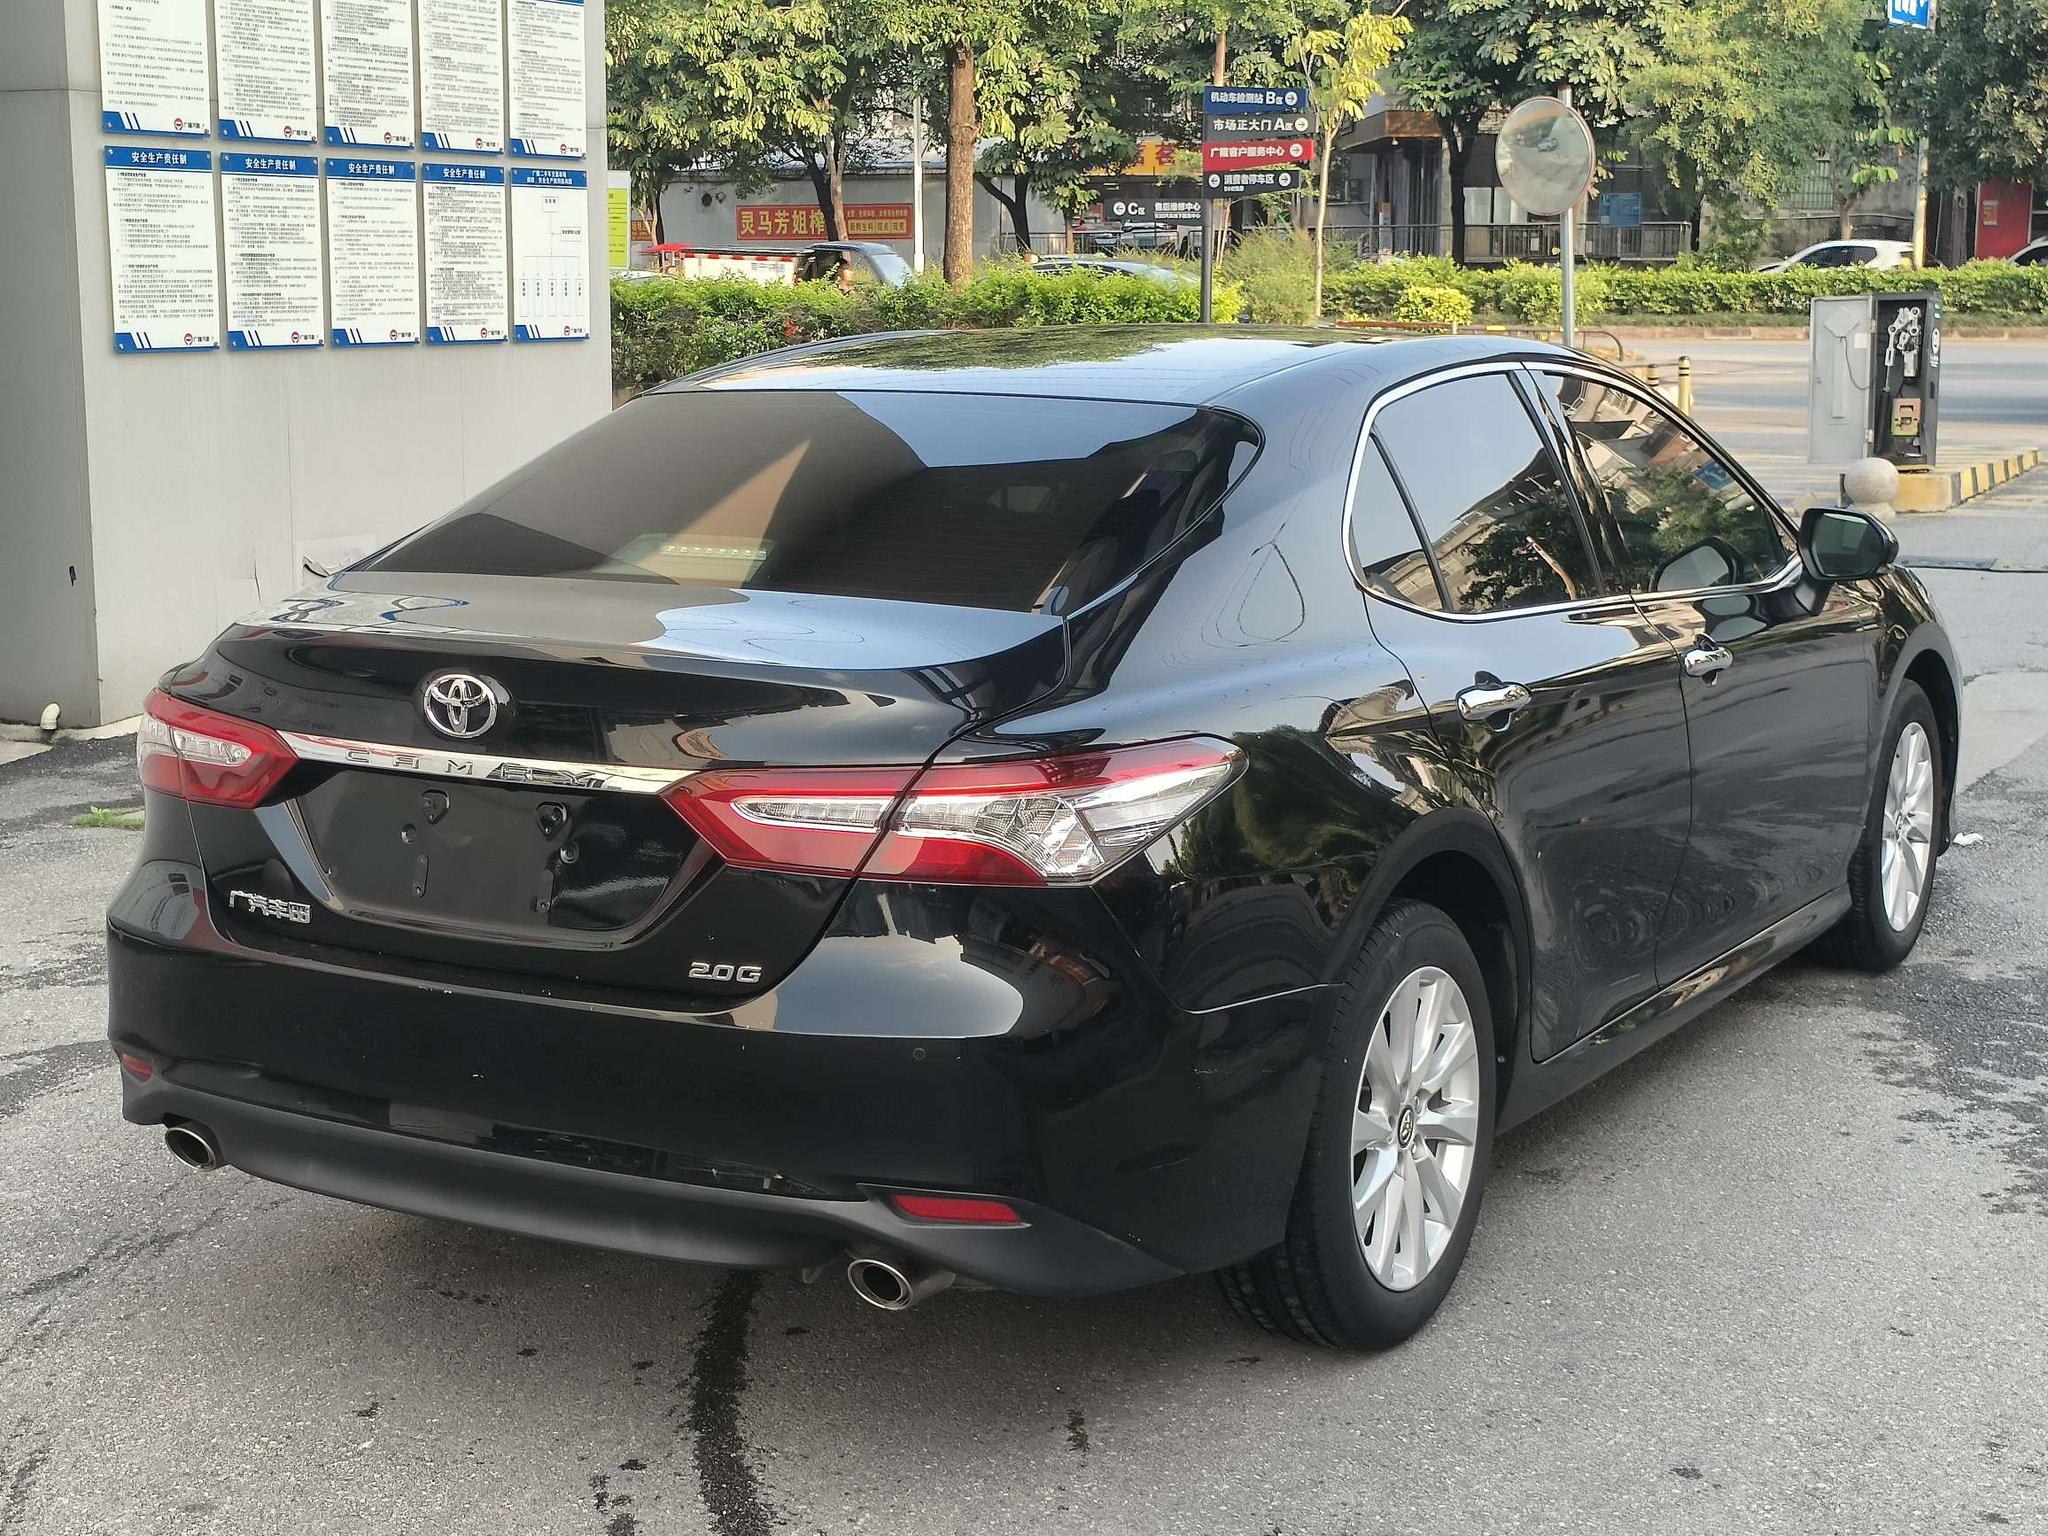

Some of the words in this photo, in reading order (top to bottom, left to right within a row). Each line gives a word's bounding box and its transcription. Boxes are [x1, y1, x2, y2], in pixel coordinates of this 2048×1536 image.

[1210, 91, 1264, 104] 机动车检测站
[1213, 119, 1271, 131] 市场正大门
[131, 151, 187, 165] 安全生产责任制
[245, 157, 296, 171] 安全生产责任制
[348, 162, 395, 175] 安全生产责任制
[443, 167, 486, 180] 安全生产责任制
[344, 748, 597, 787] CAMRY
[228, 889, 311, 924] 广汽丰田
